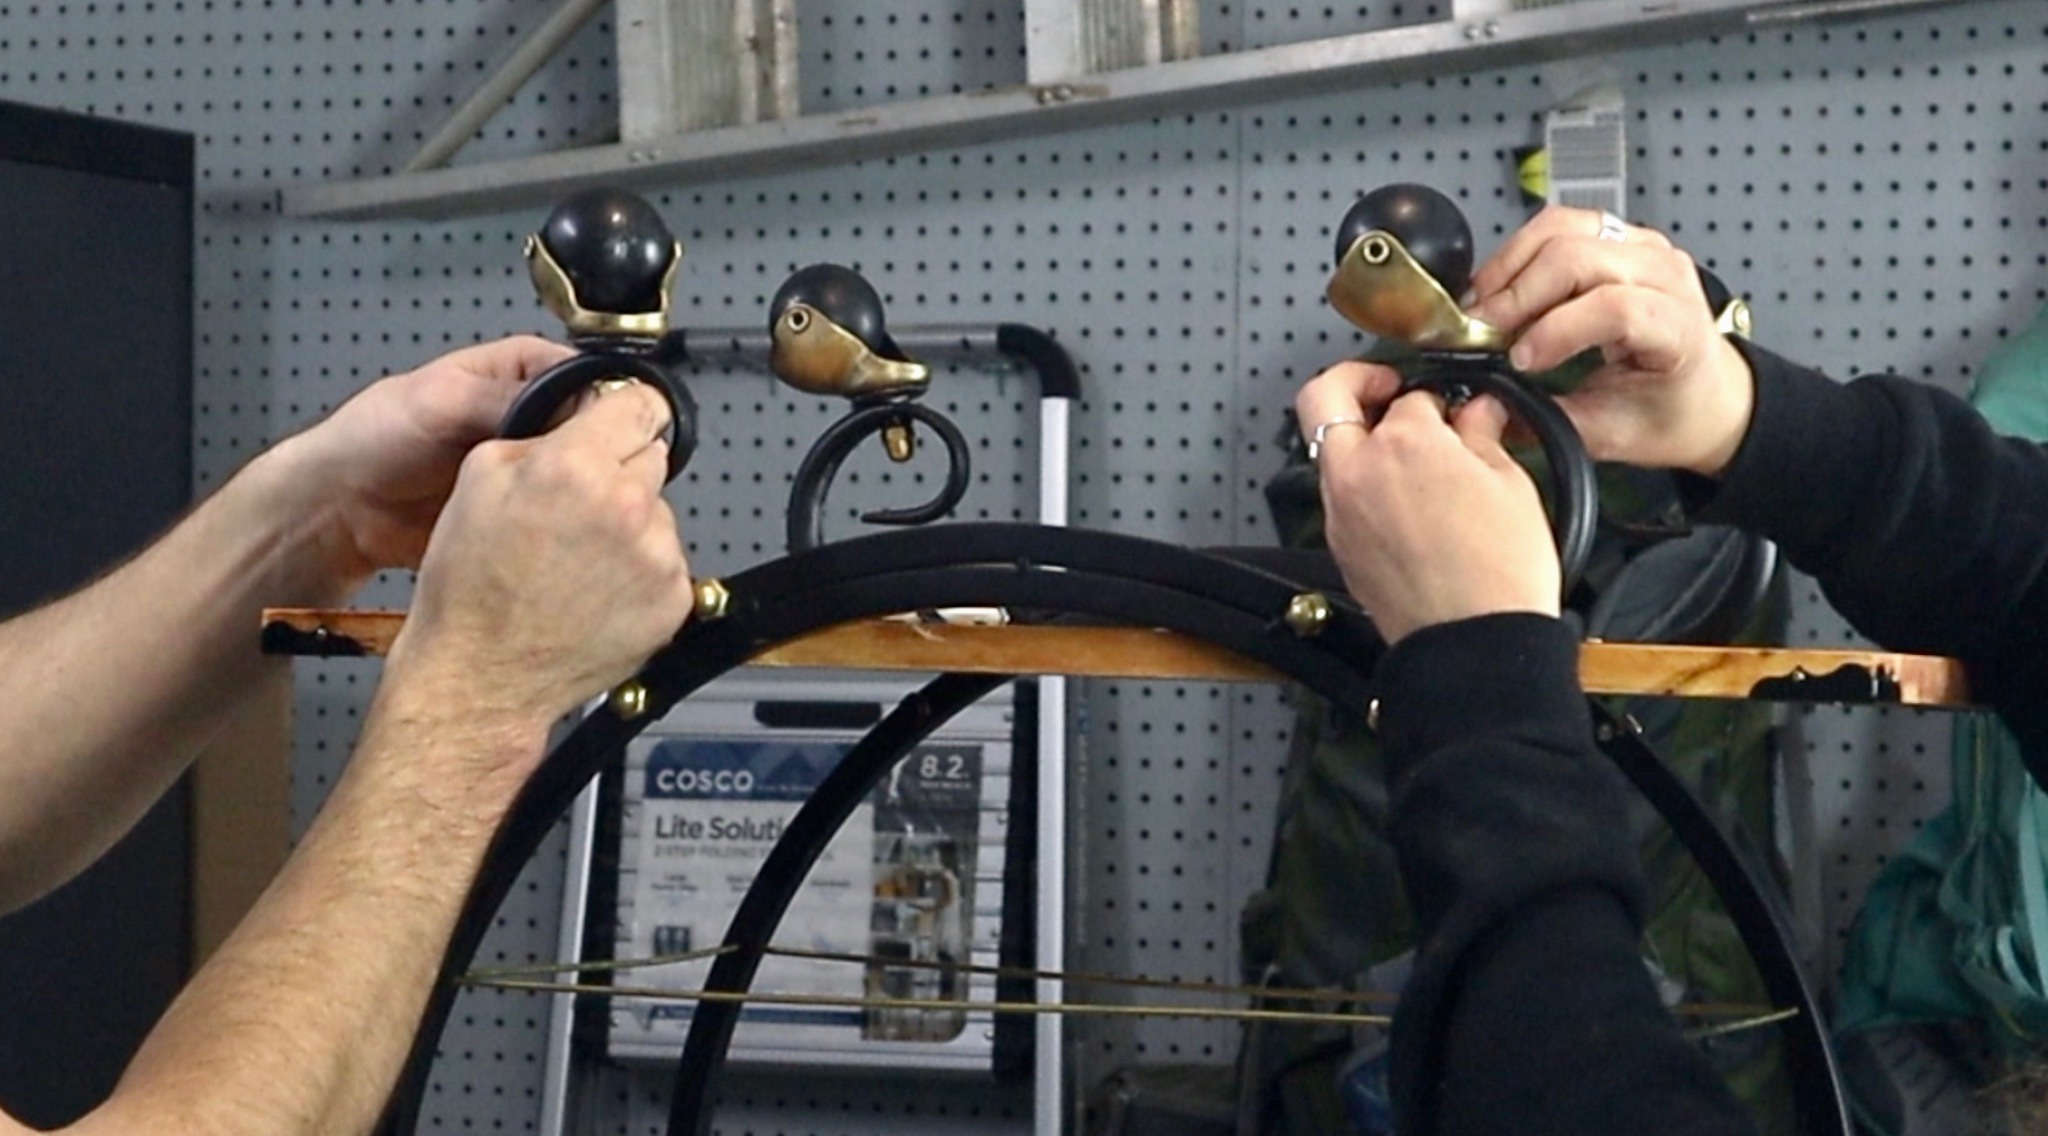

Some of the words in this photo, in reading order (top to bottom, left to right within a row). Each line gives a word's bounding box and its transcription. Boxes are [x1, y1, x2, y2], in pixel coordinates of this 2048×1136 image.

[656, 769, 754, 793] COSCO
[655, 814, 703, 839] Lite
[709, 816, 784, 841] Soluti
